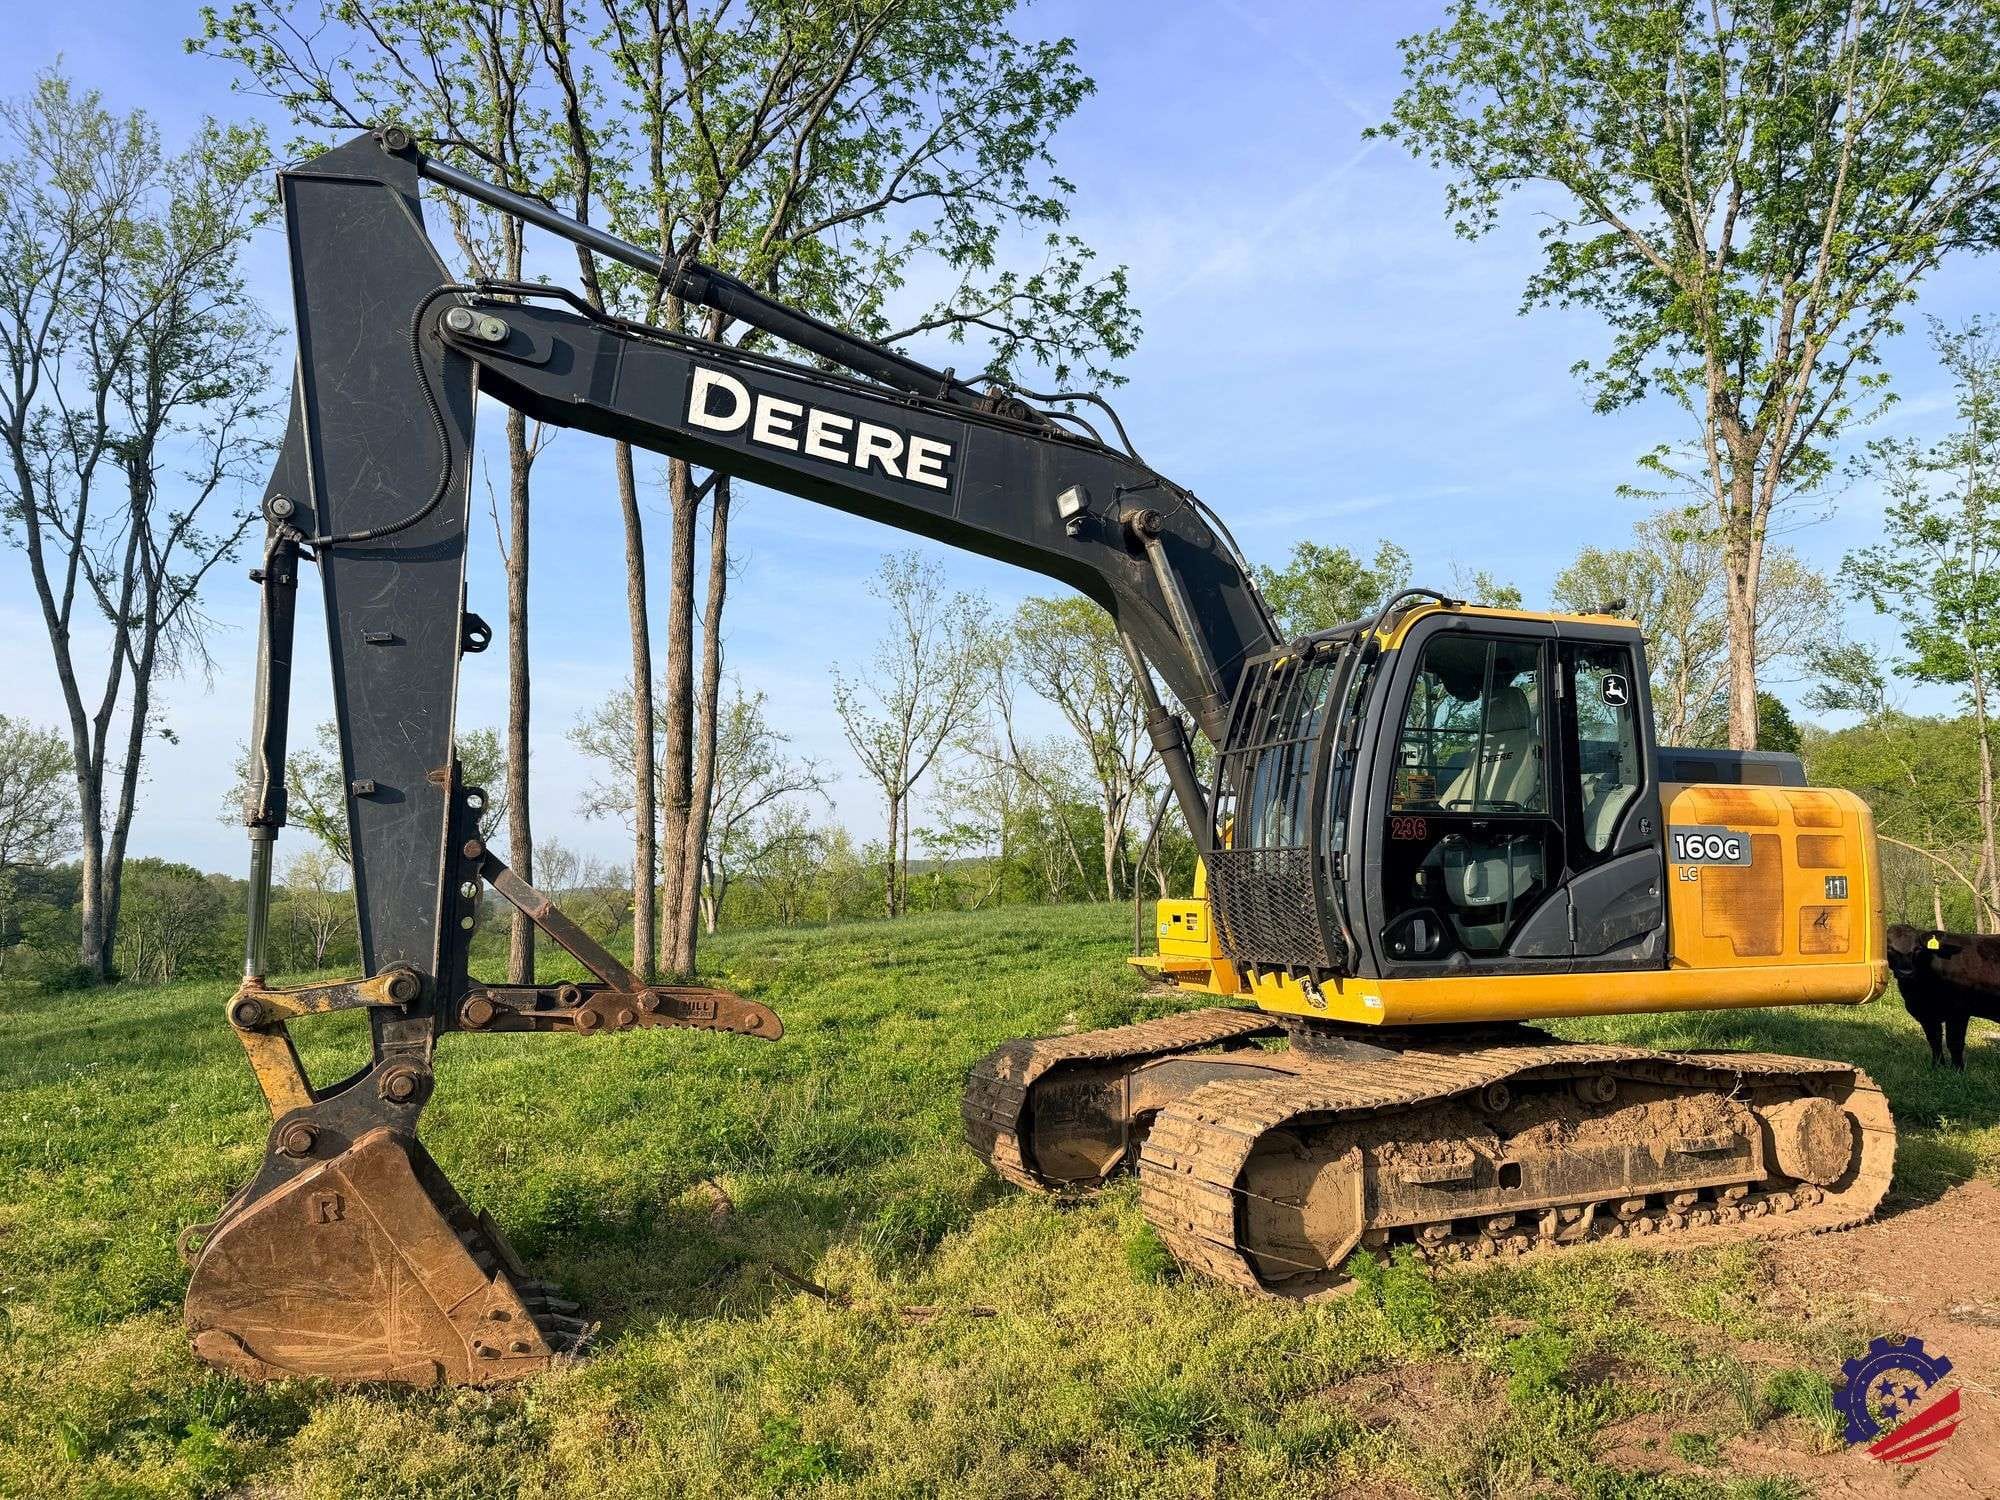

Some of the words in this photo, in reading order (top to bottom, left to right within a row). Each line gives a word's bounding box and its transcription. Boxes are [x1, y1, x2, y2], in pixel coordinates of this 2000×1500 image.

[688, 366, 952, 489] DEERE
[1392, 817, 1426, 840] 236
[1675, 834, 1740, 860] 160G
[1679, 866, 1698, 881] LC
